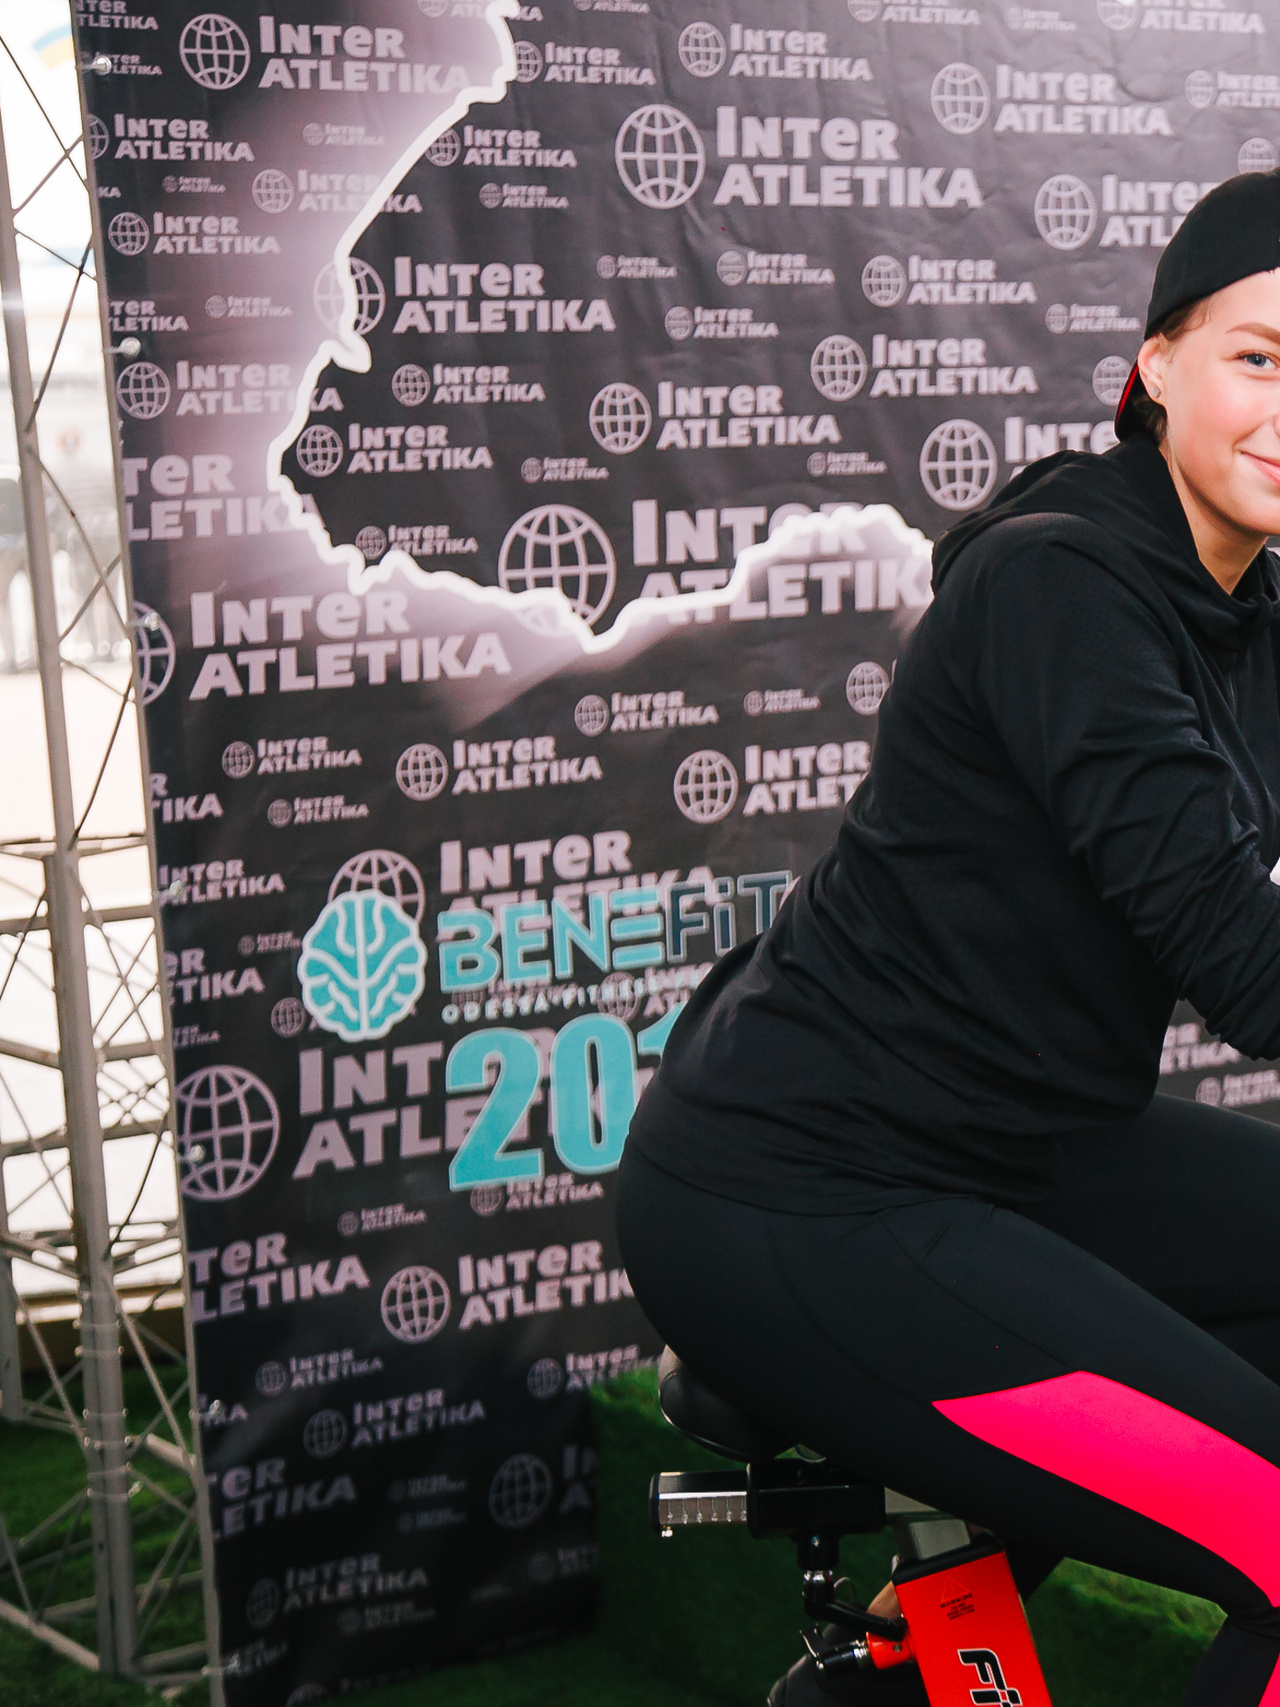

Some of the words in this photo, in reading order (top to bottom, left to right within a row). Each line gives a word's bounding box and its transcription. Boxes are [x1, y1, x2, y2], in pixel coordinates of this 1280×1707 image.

[258, 58, 470, 94] ATLETIKA
[730, 54, 873, 81] ATLETIKA
[994, 104, 1174, 136] ATLETIKA
[115, 139, 254, 161] ATLETIKA
[714, 163, 984, 208] ATLETIKA
[153, 234, 281, 255] ATLETIKA
[393, 299, 617, 333] ATLETIKA
[870, 365, 1038, 398] ATLETIKA
[656, 415, 841, 450] ATLETIKA
[121, 453, 235, 497] TeR
[347, 446, 494, 474] ATLETIKA
[189, 632, 511, 701] ATLETIKA
[452, 755, 603, 796] ATLETIKA
